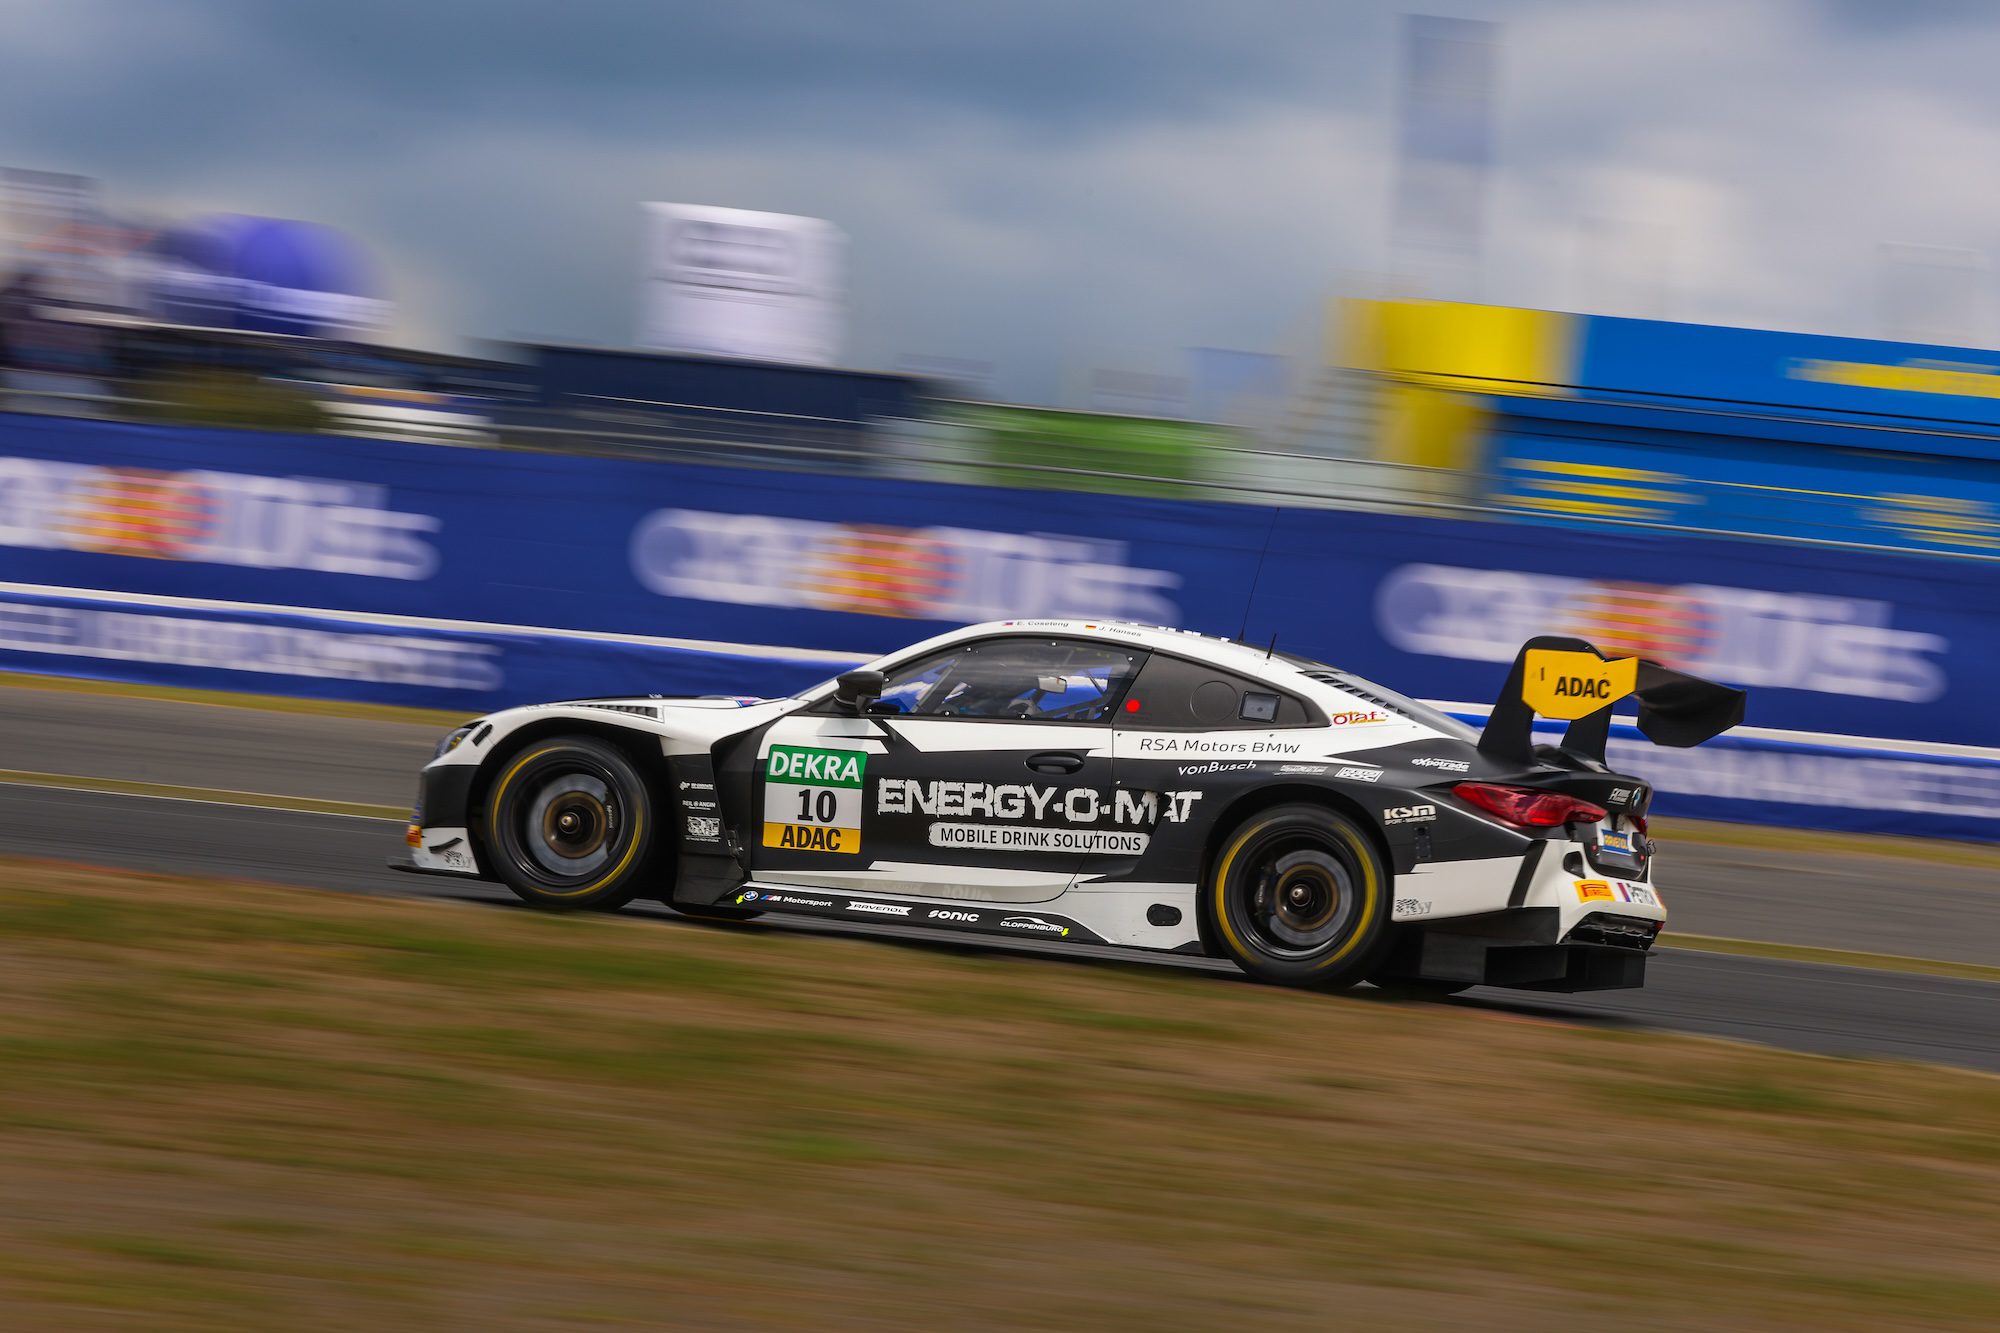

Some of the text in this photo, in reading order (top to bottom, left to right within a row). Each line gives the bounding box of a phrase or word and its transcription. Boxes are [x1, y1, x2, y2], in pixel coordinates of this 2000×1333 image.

[1555, 676, 1610, 699] ADAC
[1140, 738, 1301, 754] RSA Motors BMW
[769, 751, 860, 782] DEKRA
[1178, 760, 1257, 776] vonBusch
[797, 788, 837, 823] 10
[780, 825, 841, 851] ADAC
[940, 827, 1141, 851] MOBILE DRINK SOLUTIONS
[783, 896, 833, 907] Motorsport
[1000, 920, 1064, 933] CLOPPENBURG
